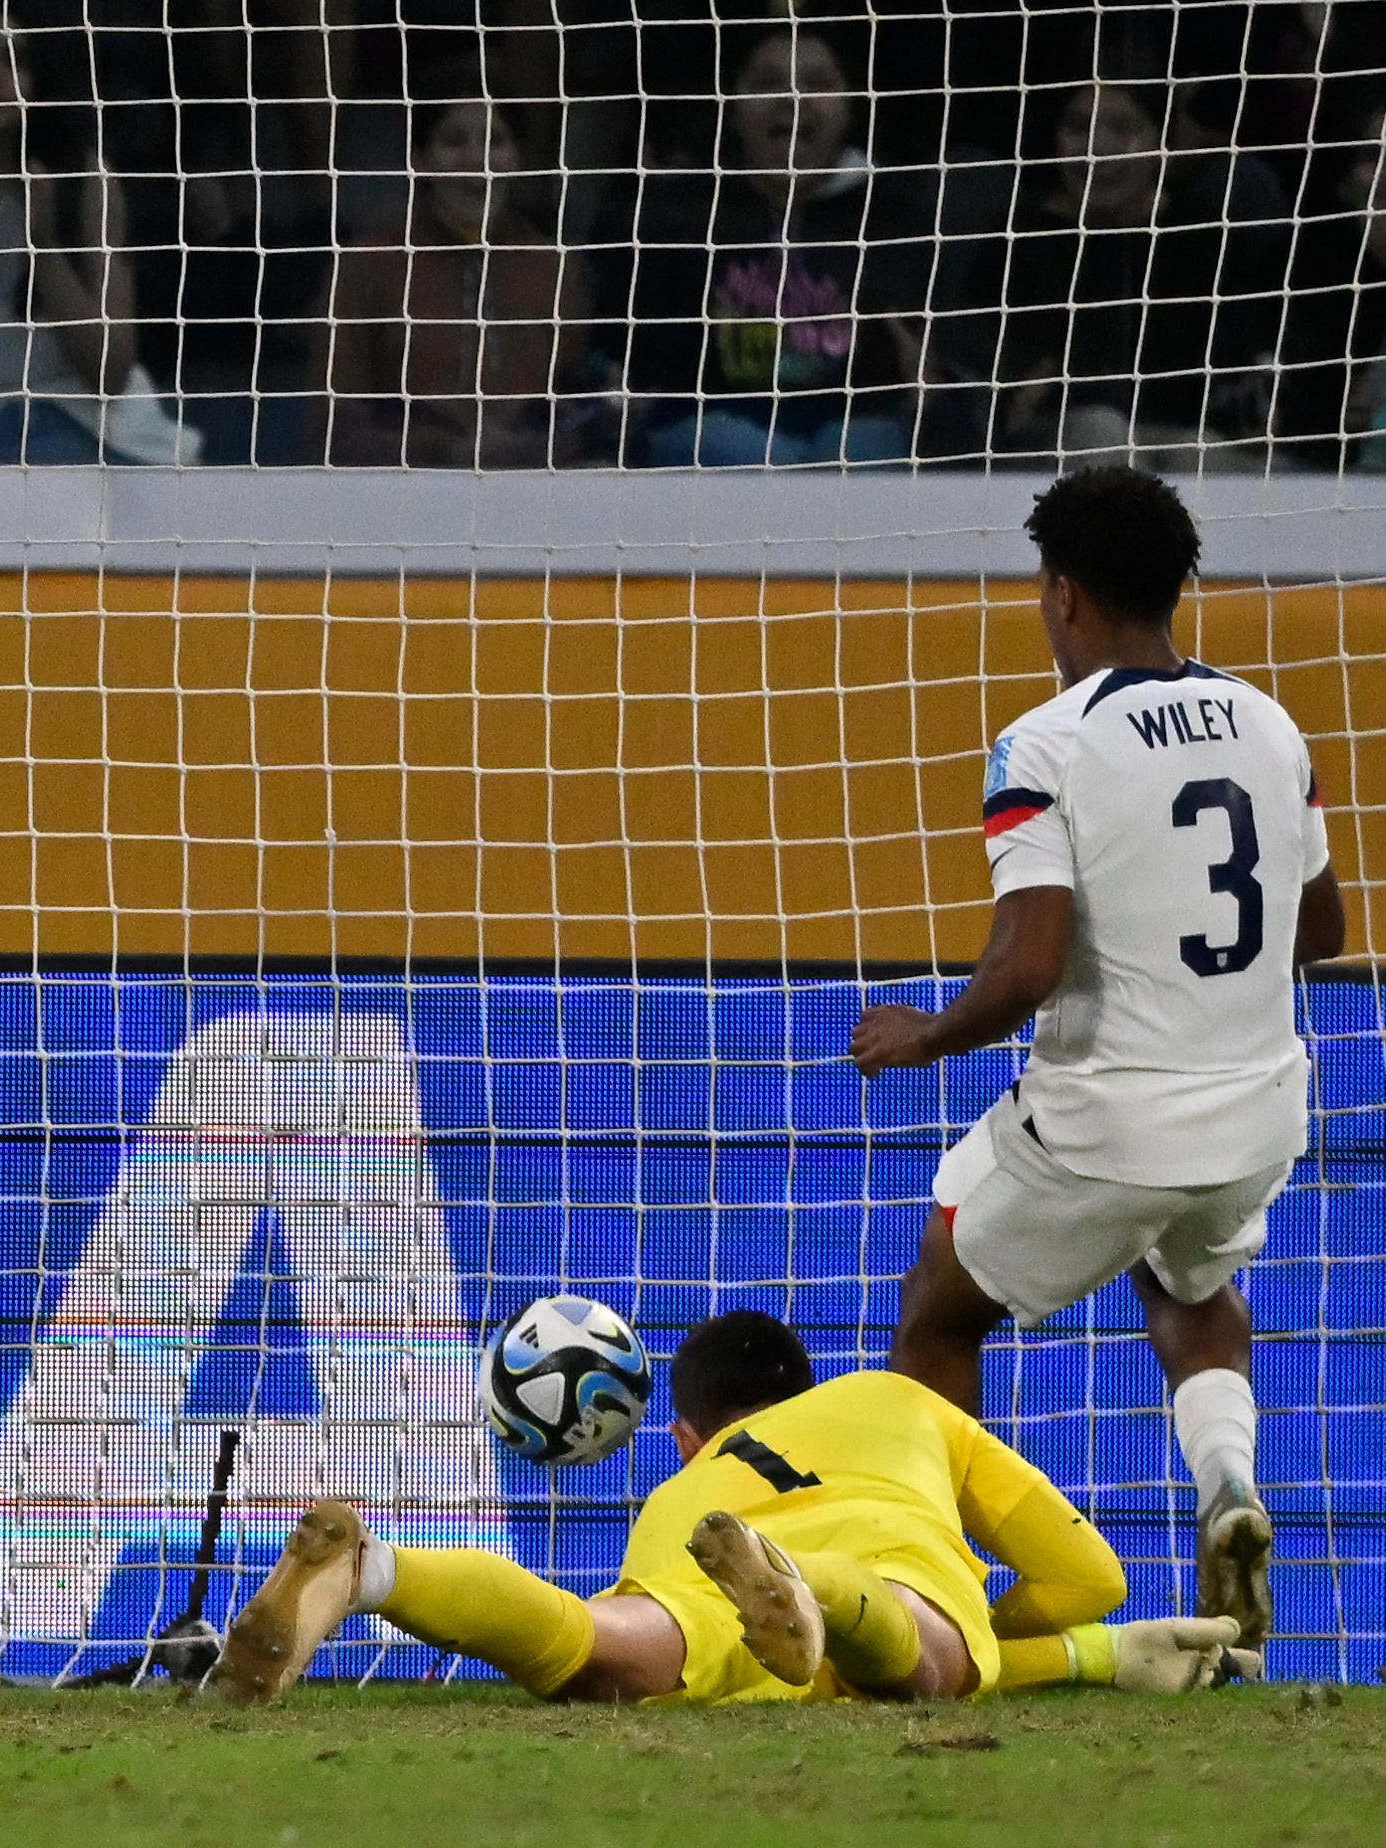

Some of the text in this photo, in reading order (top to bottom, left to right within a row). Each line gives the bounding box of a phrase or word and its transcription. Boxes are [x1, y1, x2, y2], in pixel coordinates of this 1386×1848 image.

[1126, 698, 1239, 750] WILEY
[1171, 776, 1263, 978] 3
[712, 1429, 823, 1494] 1
